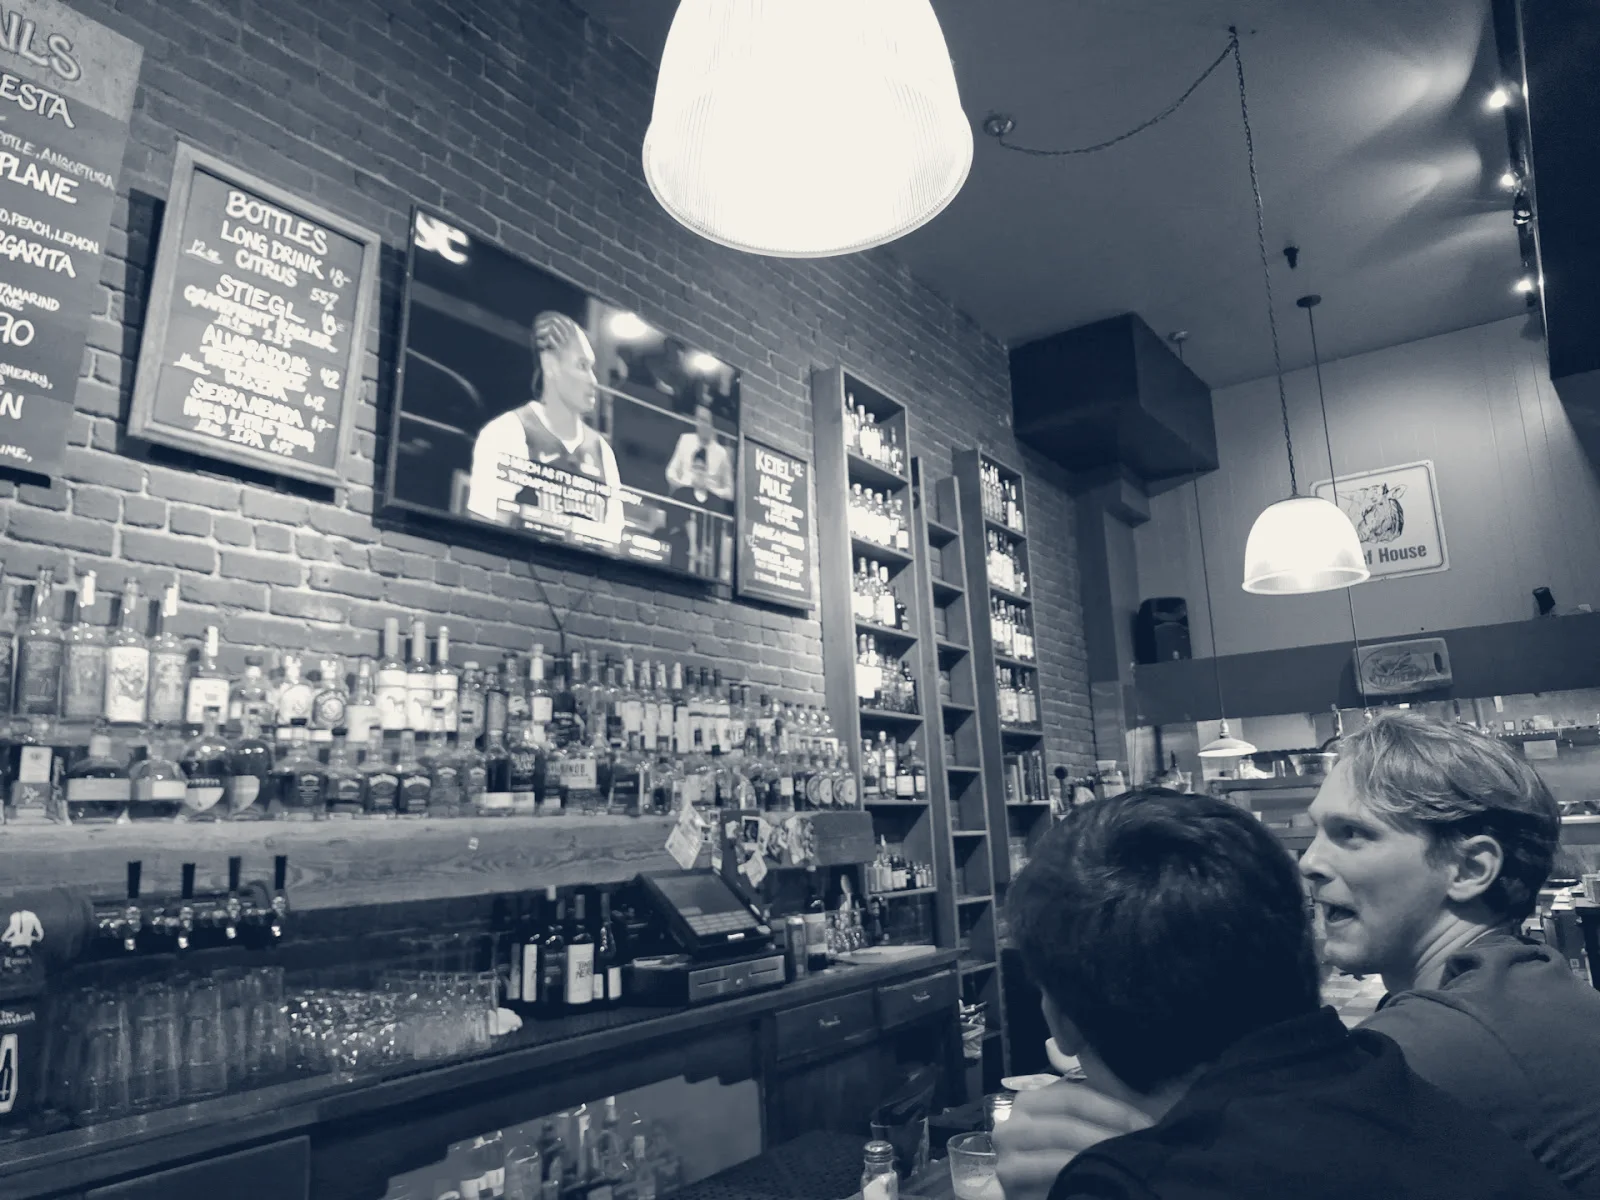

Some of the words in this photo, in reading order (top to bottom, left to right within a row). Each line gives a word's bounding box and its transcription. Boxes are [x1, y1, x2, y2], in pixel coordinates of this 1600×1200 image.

[0, 5, 81, 81] ILS
[0, 73, 75, 129] ESTA
[0, 151, 79, 203] PLANE
[54, 229, 99, 255] LEMON
[224, 191, 329, 255] BOTTLES
[220, 220, 267, 257] LONG
[271, 239, 325, 280] DRINK
[235, 249, 298, 287] CITRUS
[215, 274, 306, 324] STIEGL
[1378, 544, 1427, 563] House
